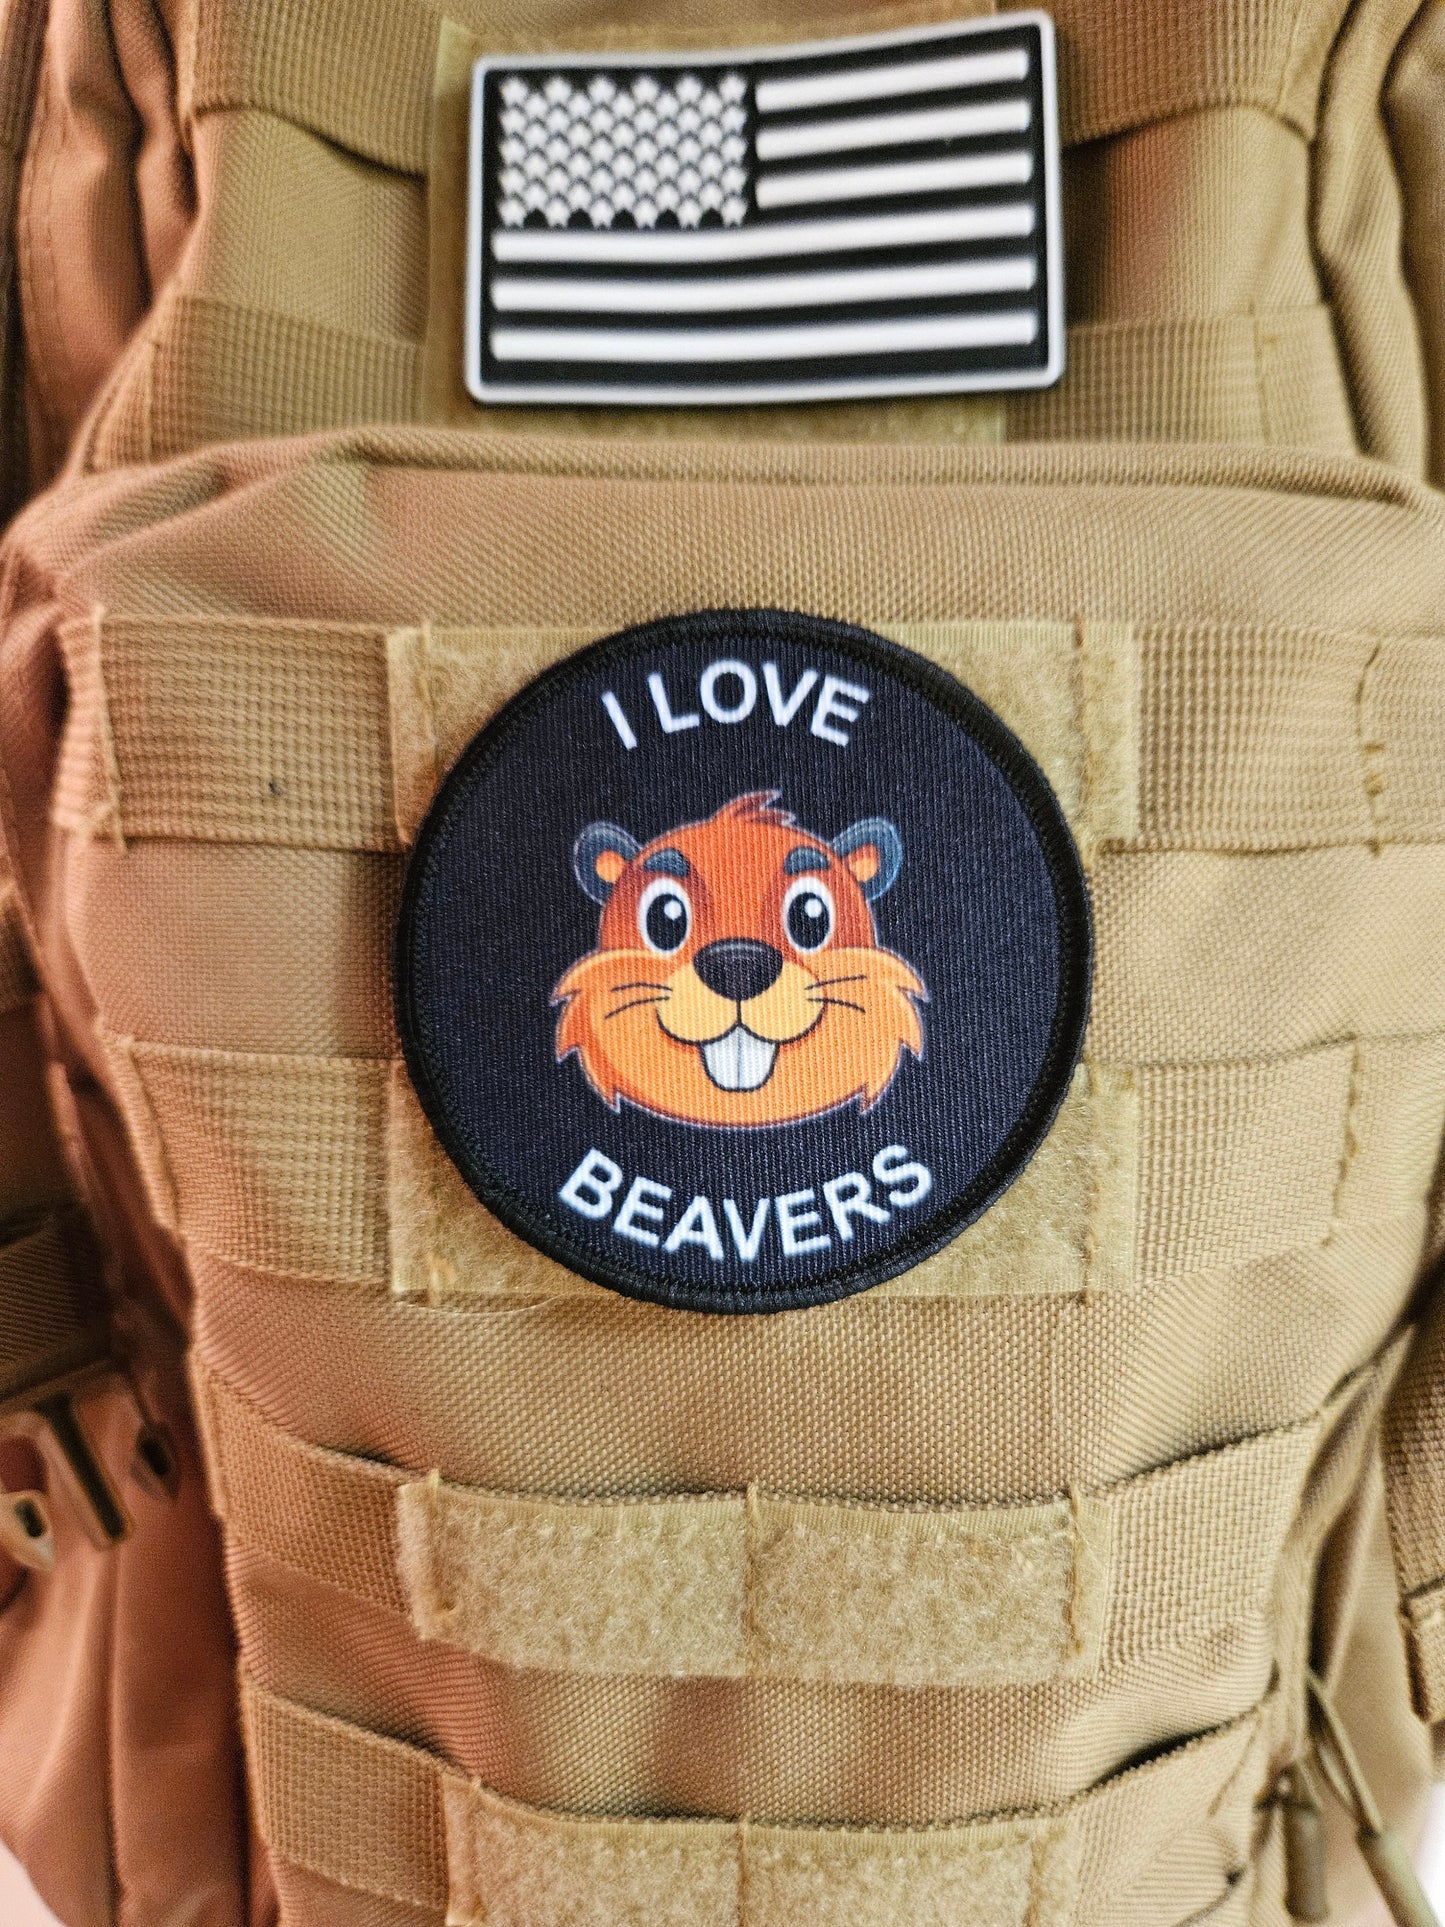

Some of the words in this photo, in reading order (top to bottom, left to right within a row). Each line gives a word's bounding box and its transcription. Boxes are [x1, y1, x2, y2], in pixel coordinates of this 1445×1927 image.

[601, 690, 638, 750] I
[647, 659, 870, 748] LOVE
[557, 1144, 933, 1262] BEAVERS
